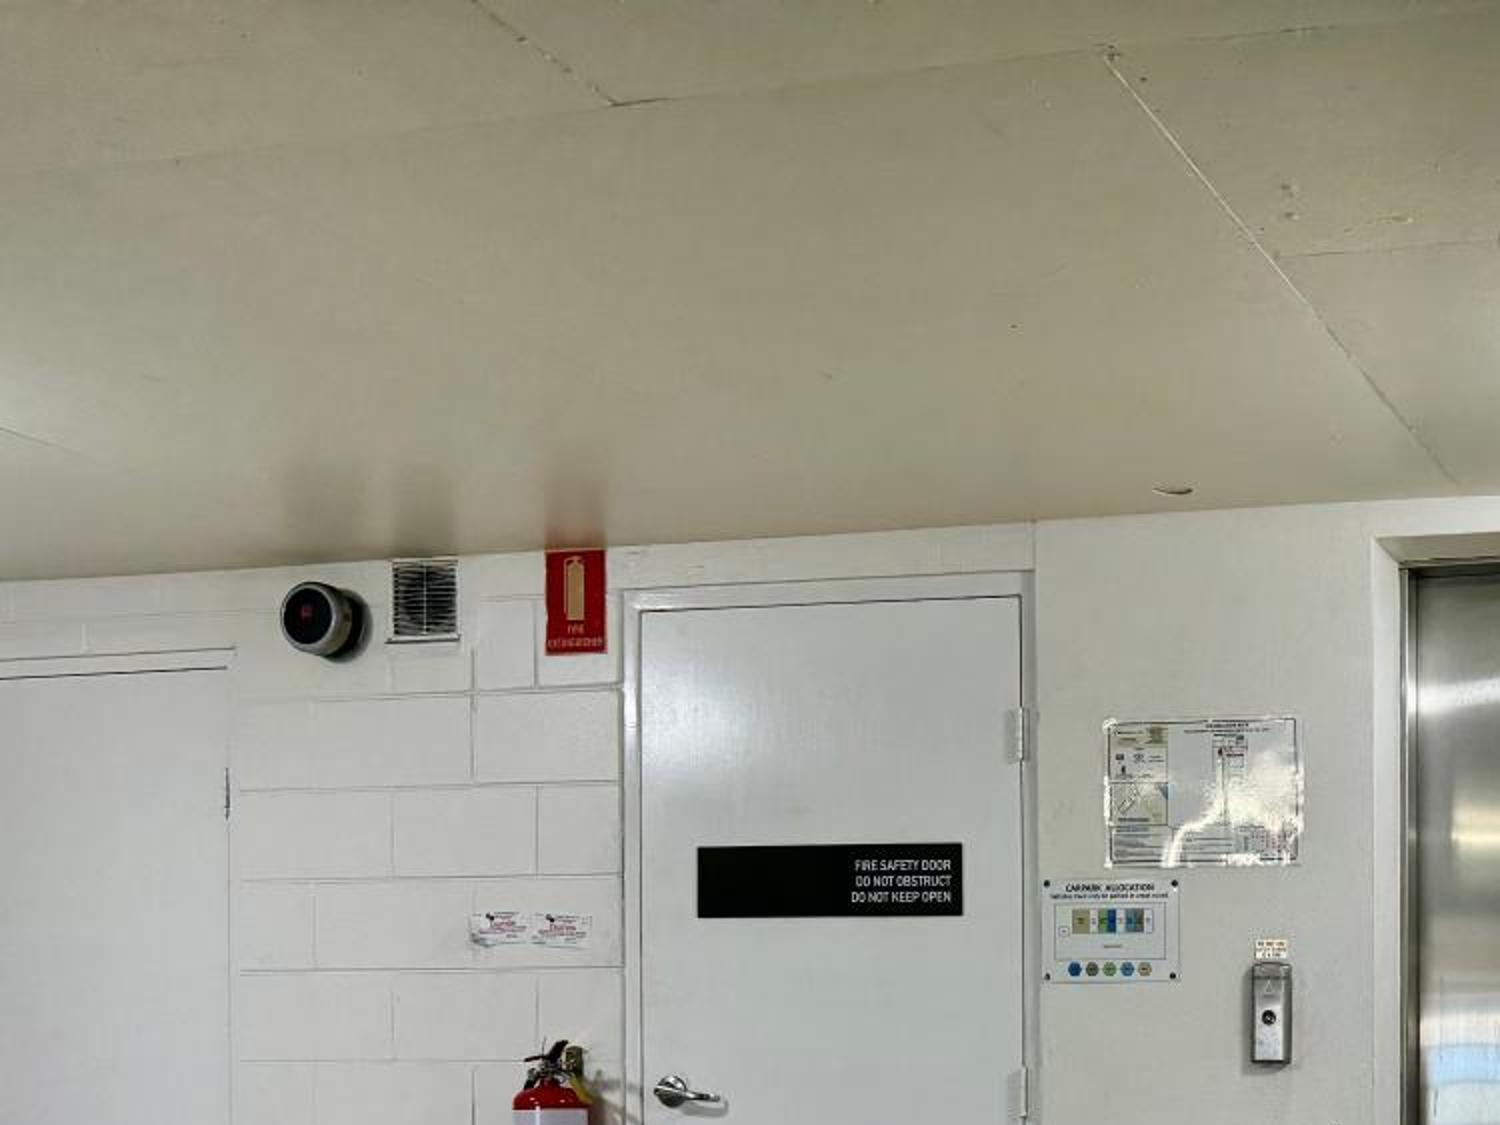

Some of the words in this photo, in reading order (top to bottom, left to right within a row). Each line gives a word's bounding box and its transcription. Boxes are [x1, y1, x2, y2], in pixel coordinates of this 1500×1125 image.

[854, 859, 878, 871] FIRE
[880, 859, 920, 871] SAFETY
[921, 859, 952, 871] DOOR
[855, 875, 871, 887] DO
[873, 875, 894, 887] NOT
[895, 875, 952, 887] OBSTRUCT
[851, 891, 866, 903] DO
[867, 891, 889, 903] NOT
[891, 891, 920, 903] KEEP
[921, 891, 952, 903] OPEN
